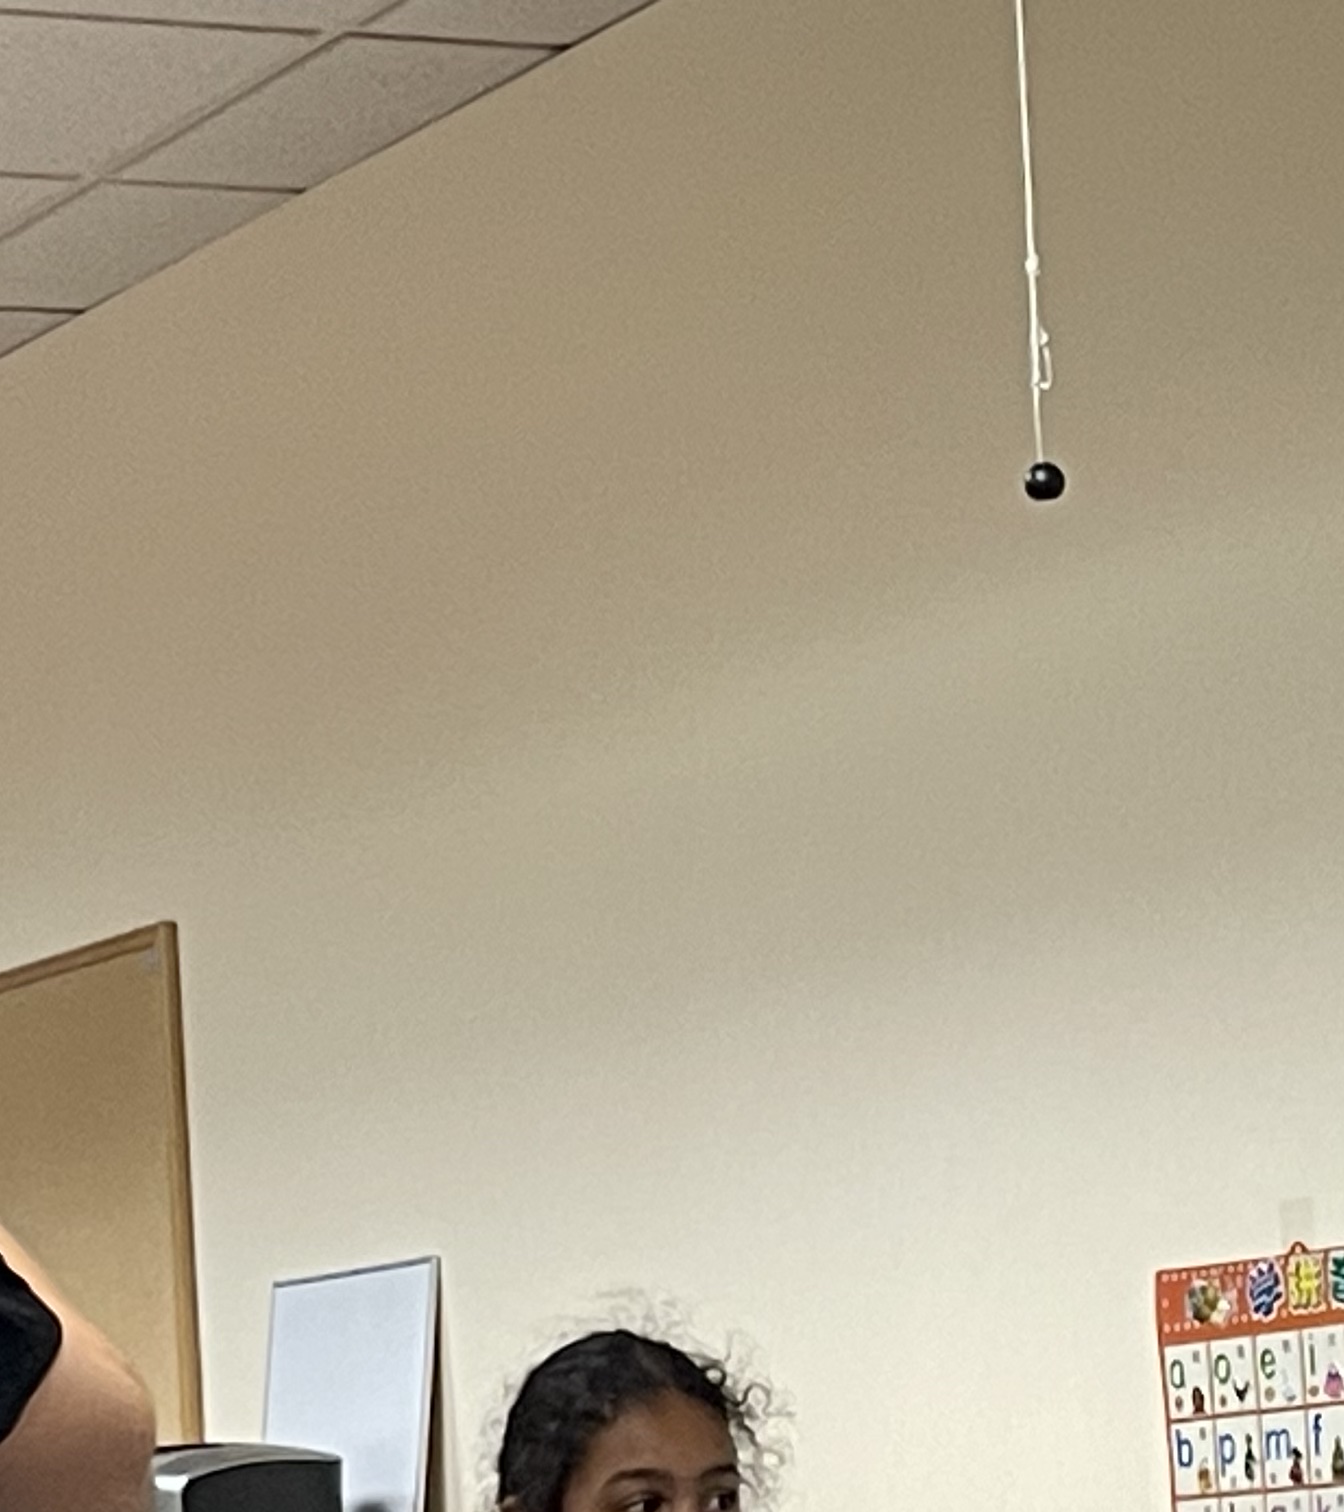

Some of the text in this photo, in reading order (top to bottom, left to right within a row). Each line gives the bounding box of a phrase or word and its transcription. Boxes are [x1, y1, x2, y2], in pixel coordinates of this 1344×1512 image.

[1214, 1354, 1231, 1384] o
[1260, 1348, 1276, 1380] e
[1308, 1333, 1316, 1375] i
[1176, 1429, 1193, 1467] b
[1219, 1433, 1236, 1477] p
[1265, 1428, 1291, 1460] m
[1313, 1413, 1322, 1456] f
